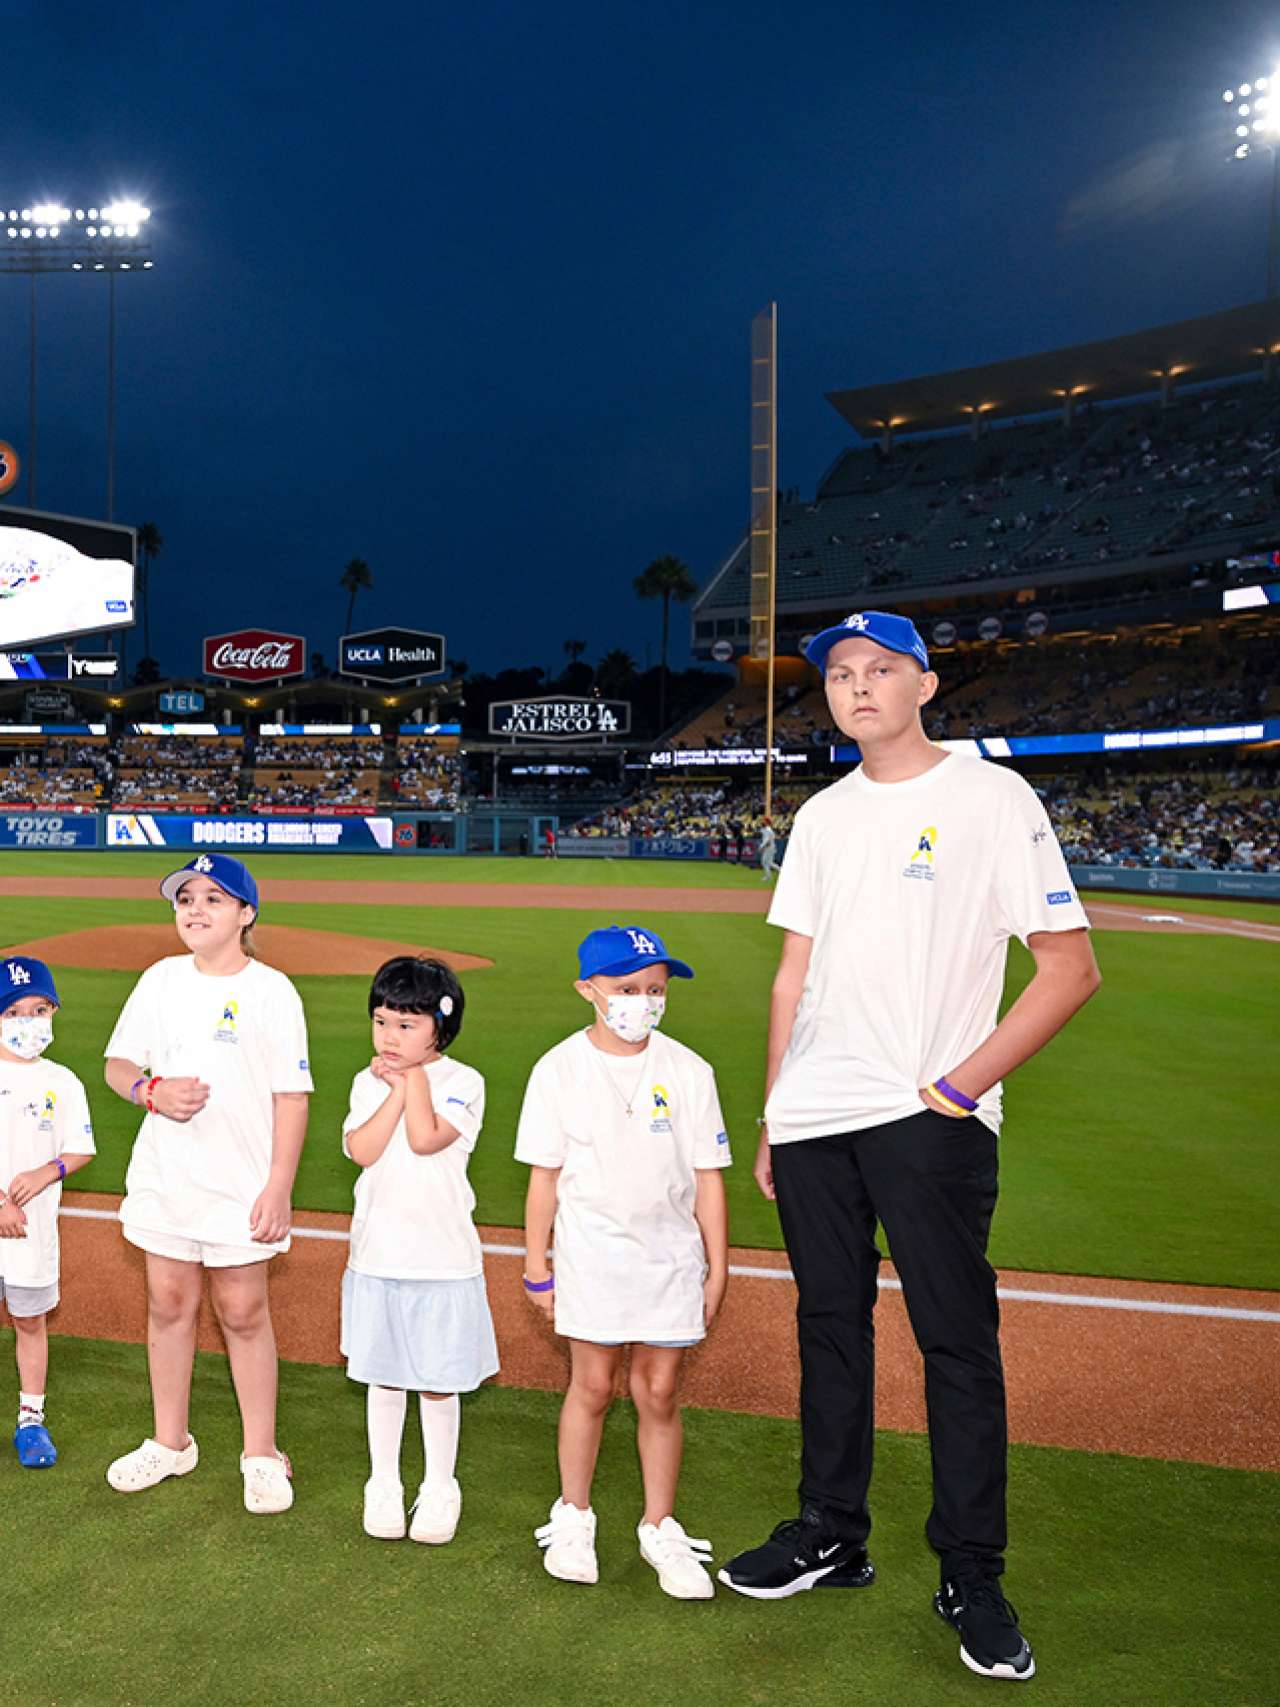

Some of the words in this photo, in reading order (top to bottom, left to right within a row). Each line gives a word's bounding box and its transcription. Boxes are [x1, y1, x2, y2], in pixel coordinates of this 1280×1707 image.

[347, 649, 382, 661] UCLA
[389, 648, 435, 662] Health
[165, 695, 199, 710] TEL
[501, 718, 592, 732] JALISCO
[6, 816, 64, 832] TOYO
[15, 832, 77, 846] TIRES
[193, 822, 265, 843] DODGERS
[627, 930, 657, 955] LA
[8, 962, 31, 985] LA
